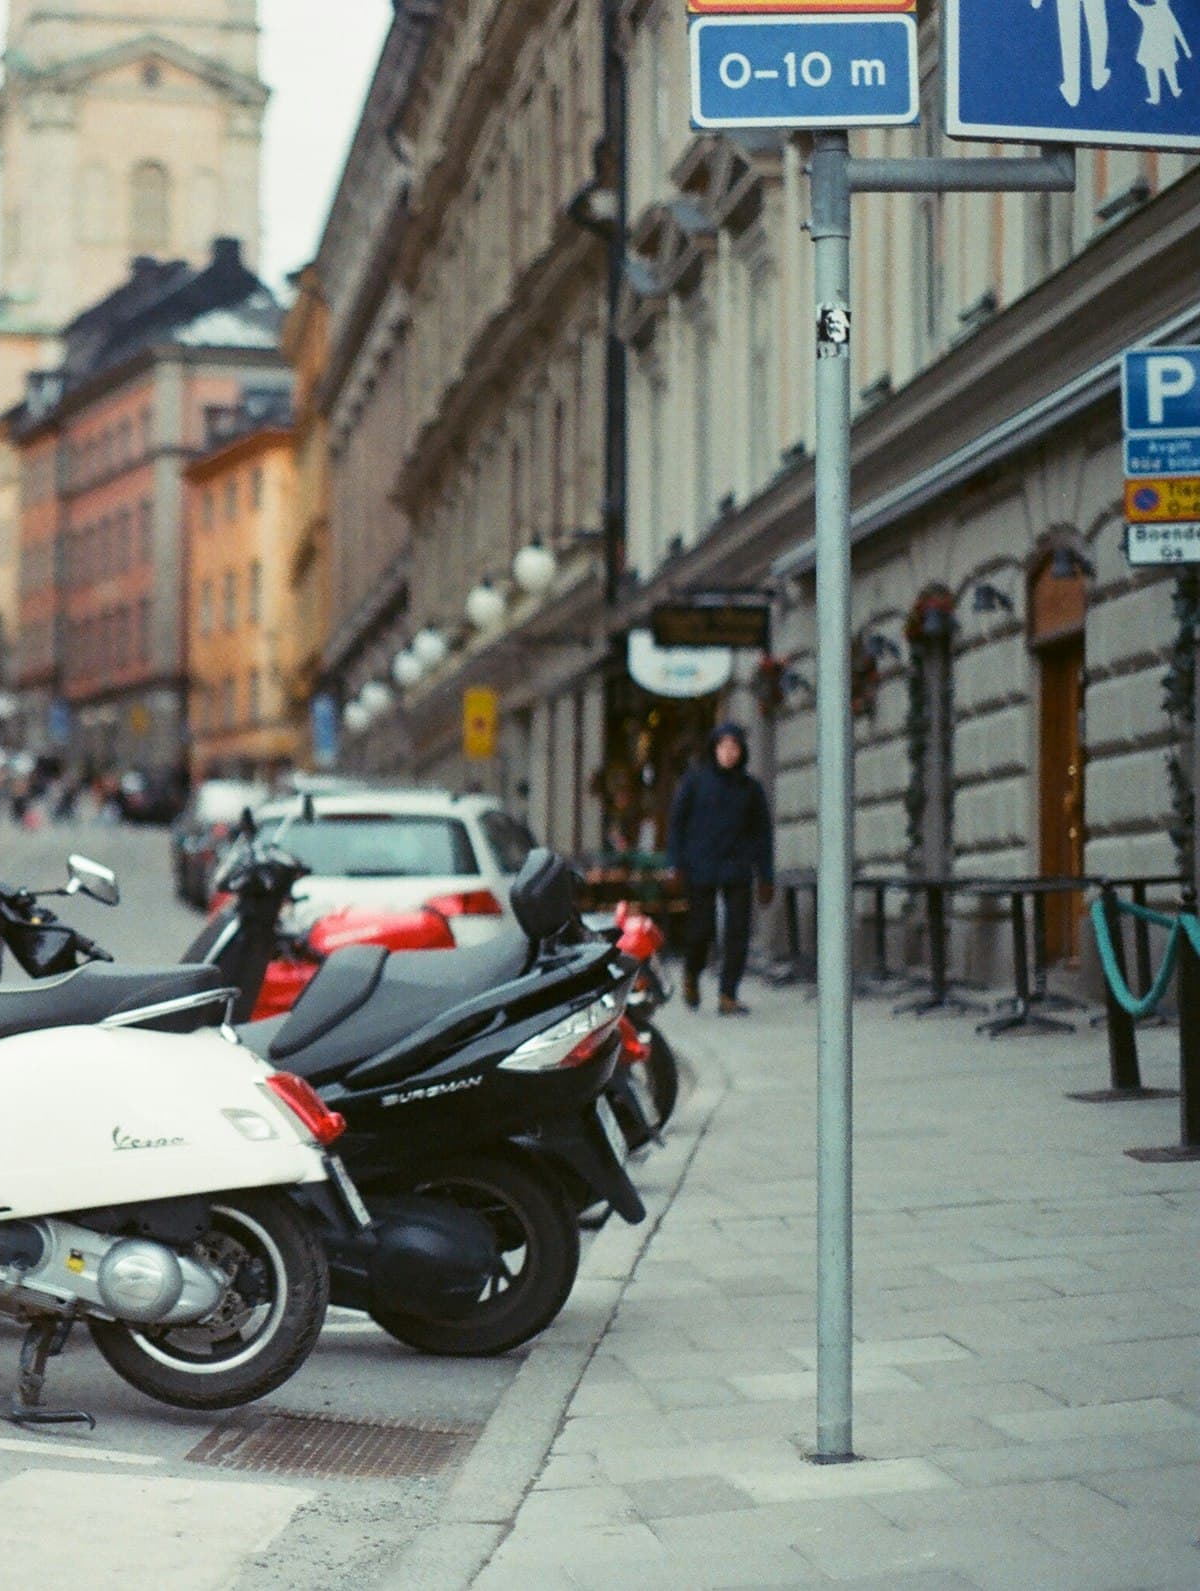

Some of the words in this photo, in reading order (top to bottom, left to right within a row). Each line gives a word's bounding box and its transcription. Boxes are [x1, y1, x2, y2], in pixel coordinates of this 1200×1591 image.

[719, 51, 832, 89] 0-10
[850, 58, 886, 87] m
[1146, 355, 1196, 424] P
